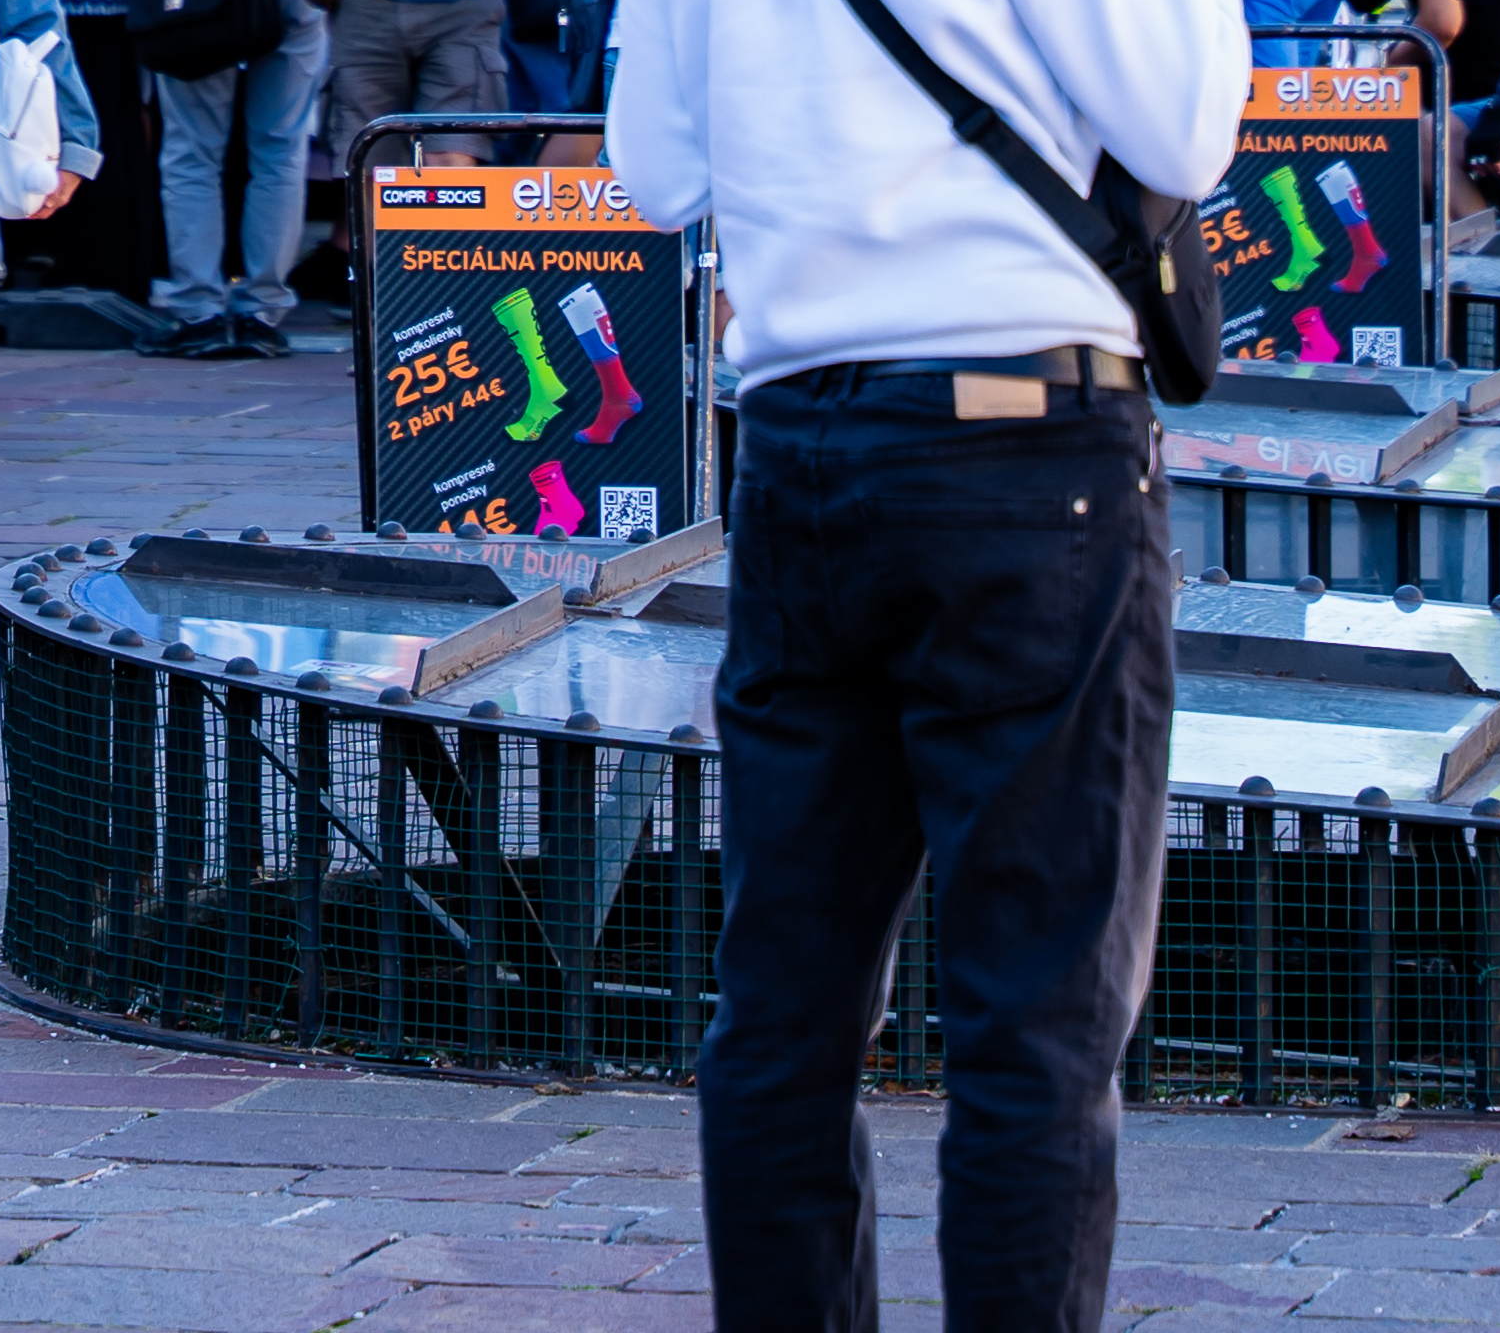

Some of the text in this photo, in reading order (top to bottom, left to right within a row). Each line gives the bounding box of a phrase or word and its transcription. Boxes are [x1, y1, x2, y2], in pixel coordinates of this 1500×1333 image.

[1302, 135, 1388, 152] PONUKA
[512, 171, 634, 211] eleve
[515, 210, 644, 222] sportswea
[1200, 209, 1250, 254] 5€
[402, 244, 644, 271] ŠPECIÁLNA PONUKA
[1234, 239, 1273, 265] 44€
[393, 306, 454, 343] kompresné
[387, 341, 479, 407] 25€
[388, 378, 506, 441] 2 páry 44€
[433, 459, 496, 494] kompresné
[440, 483, 487, 512] ponožky
